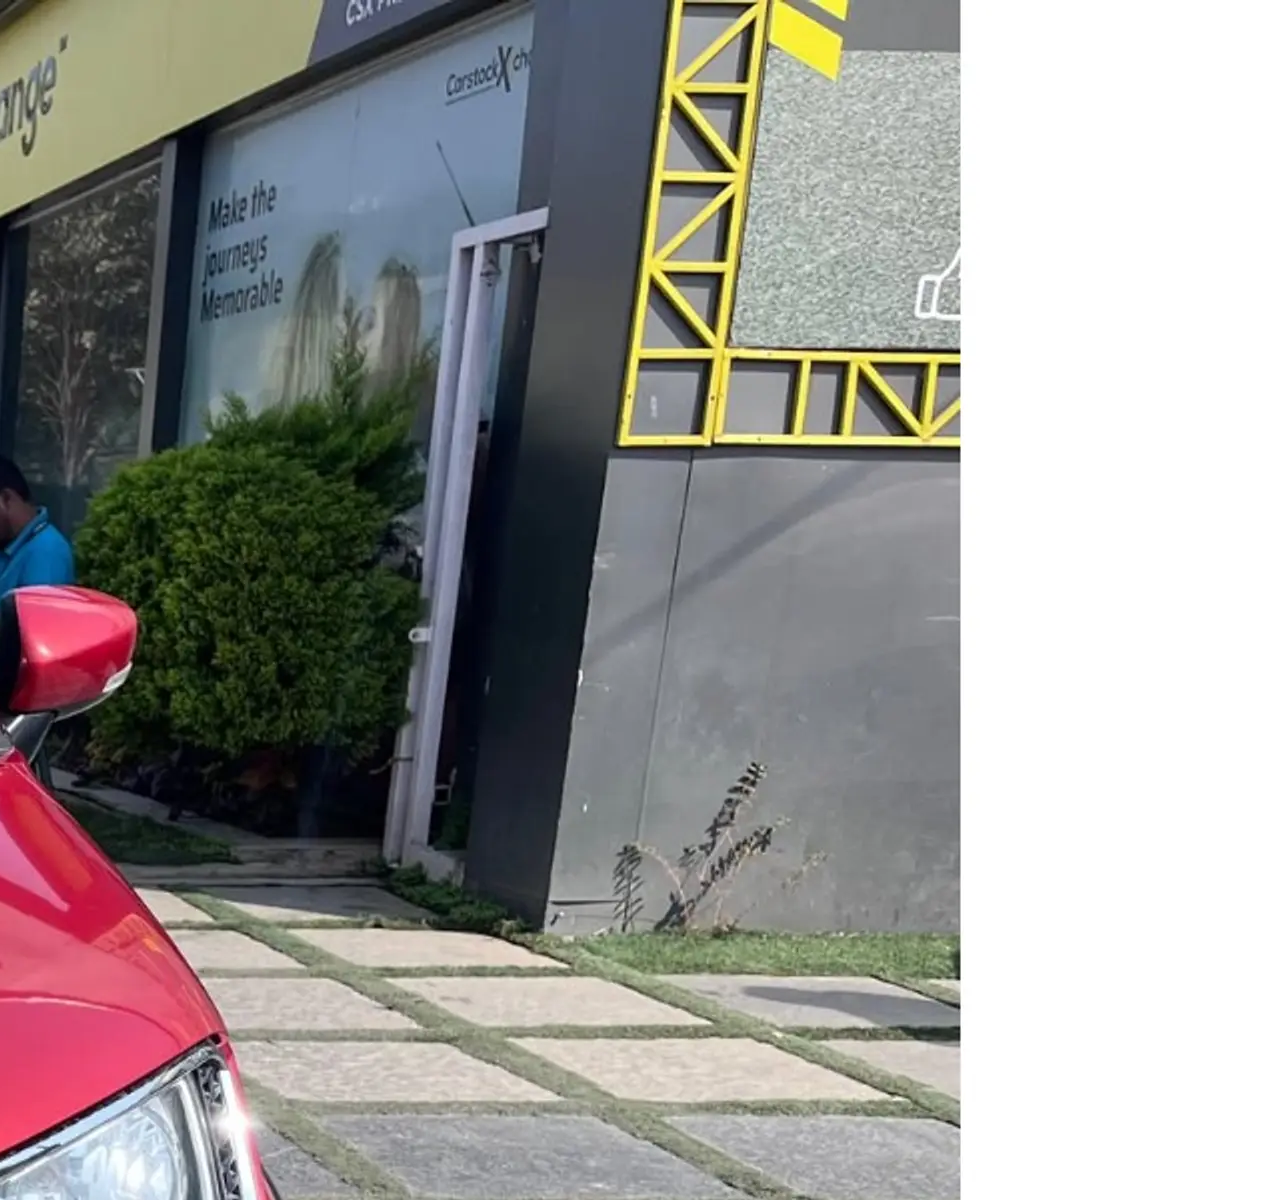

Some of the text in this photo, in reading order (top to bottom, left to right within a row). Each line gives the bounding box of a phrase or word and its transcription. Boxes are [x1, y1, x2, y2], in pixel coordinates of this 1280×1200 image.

[208, 179, 277, 233] Make the
[201, 234, 269, 288] journeys
[200, 268, 284, 324] Memorable
